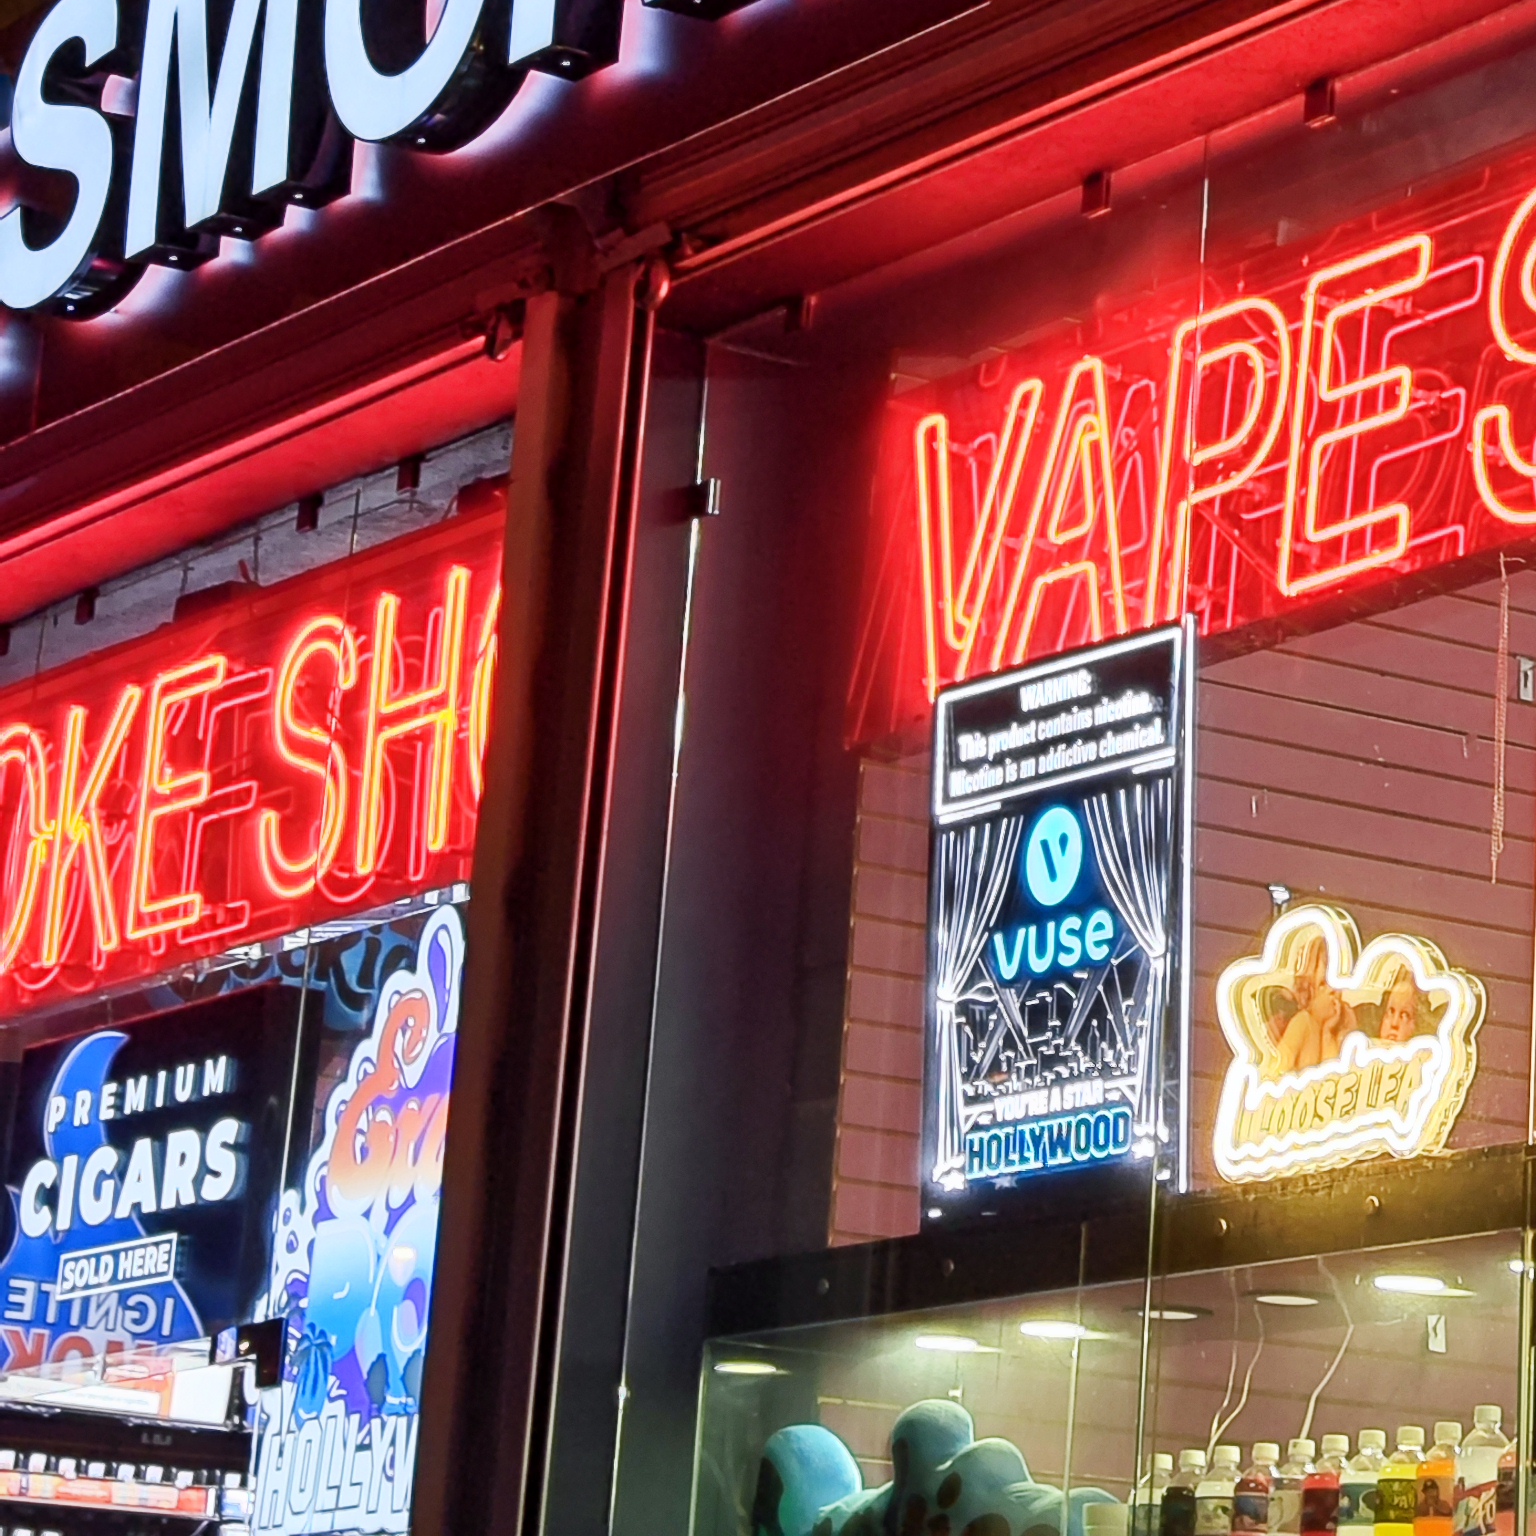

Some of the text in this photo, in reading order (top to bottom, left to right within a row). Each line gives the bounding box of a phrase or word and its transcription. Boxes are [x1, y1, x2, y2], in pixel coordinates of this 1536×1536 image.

[920, 234, 1432, 701] VAPE
[957, 731, 987, 762] This
[988, 721, 1036, 762] product
[1037, 705, 1093, 741] contains
[949, 765, 1004, 798] Nicotine
[1004, 758, 1018, 784] is
[1019, 759, 1036, 779] an
[1038, 739, 1098, 775] addictive
[47, 1056, 228, 1133] PREMIUM
[993, 1078, 1104, 1122] YOU'RE A STAR
[965, 1105, 1133, 1181] HOLLYWOOD
[20, 1119, 240, 1237] CIGARS
[62, 1242, 171, 1291] SOLD HERE
